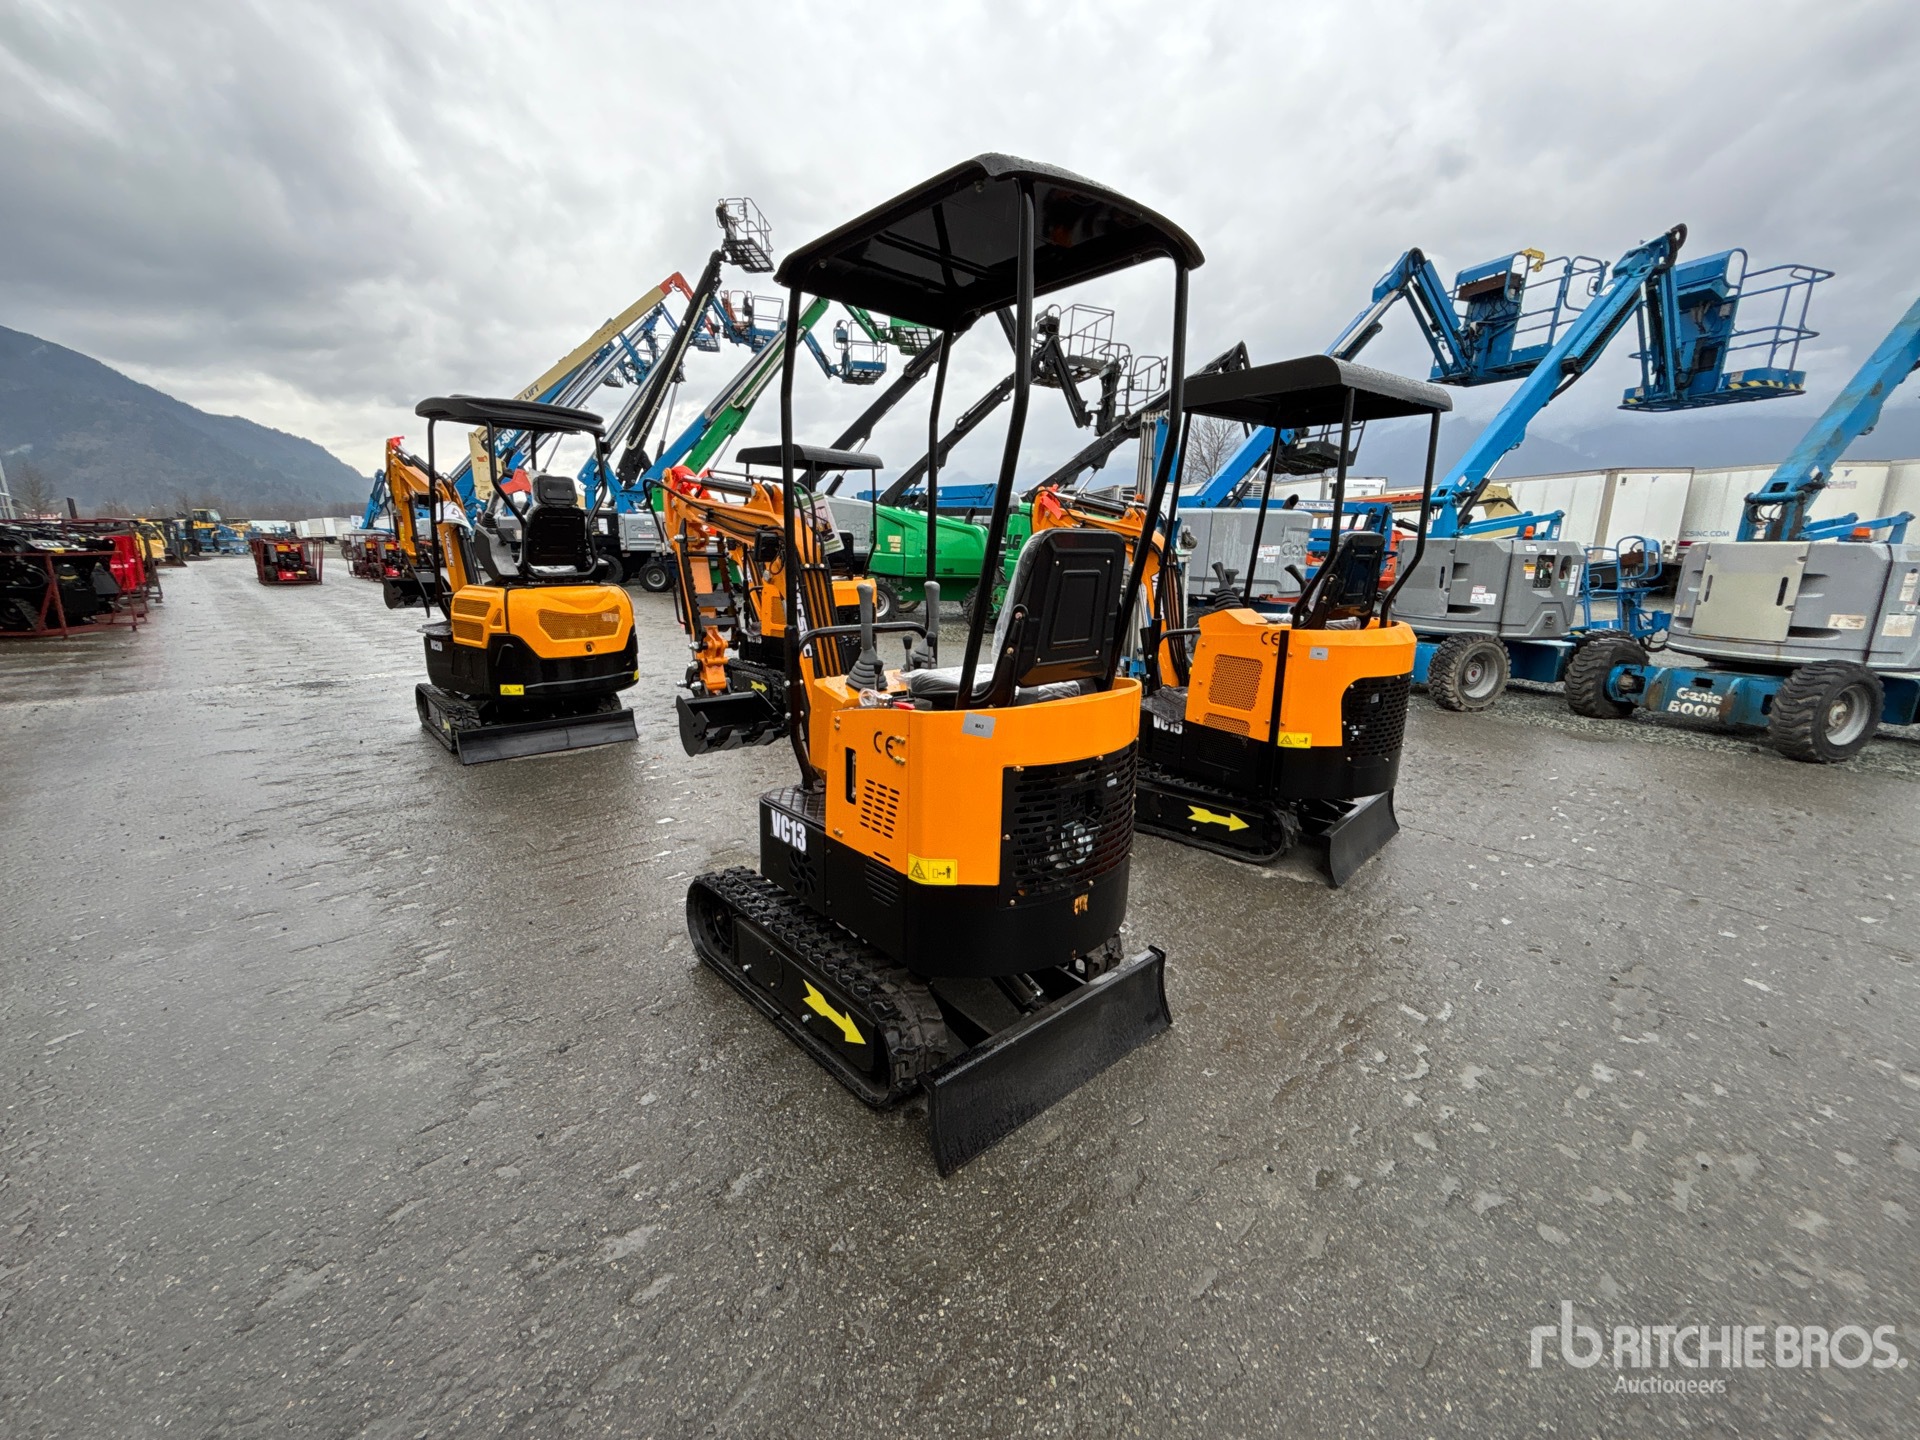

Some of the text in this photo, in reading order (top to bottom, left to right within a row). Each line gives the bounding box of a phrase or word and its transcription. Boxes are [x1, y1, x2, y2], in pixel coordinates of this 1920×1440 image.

[524, 384, 539, 399] LIFT
[1676, 687, 1723, 704] Genie
[1153, 715, 1183, 735] VC15
[771, 809, 807, 852] VC13
